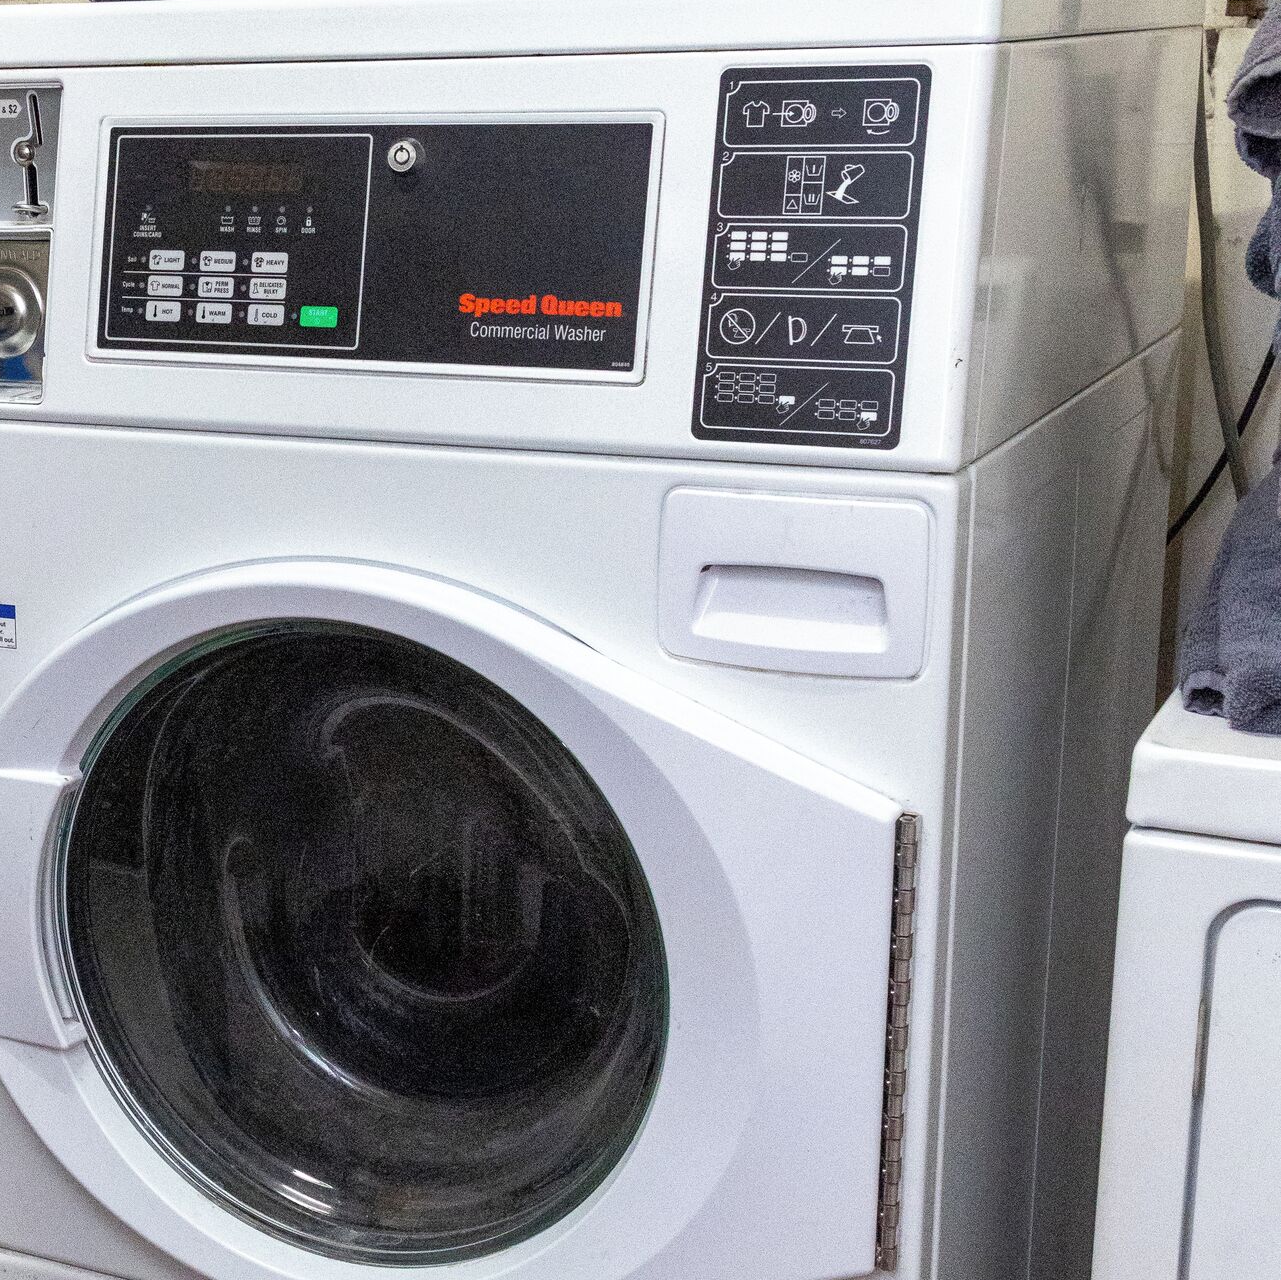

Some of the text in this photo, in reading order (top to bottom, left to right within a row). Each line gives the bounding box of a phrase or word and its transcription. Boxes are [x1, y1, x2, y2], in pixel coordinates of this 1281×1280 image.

[729, 81, 734, 90] 1
[8, 104, 18, 114] $2
[722, 151, 730, 160] 2
[716, 222, 724, 232] 3
[710, 292, 717, 301] 4
[458, 293, 623, 317] Speed Queen
[470, 321, 606, 342] Commercial Washer
[705, 363, 712, 372] 5
